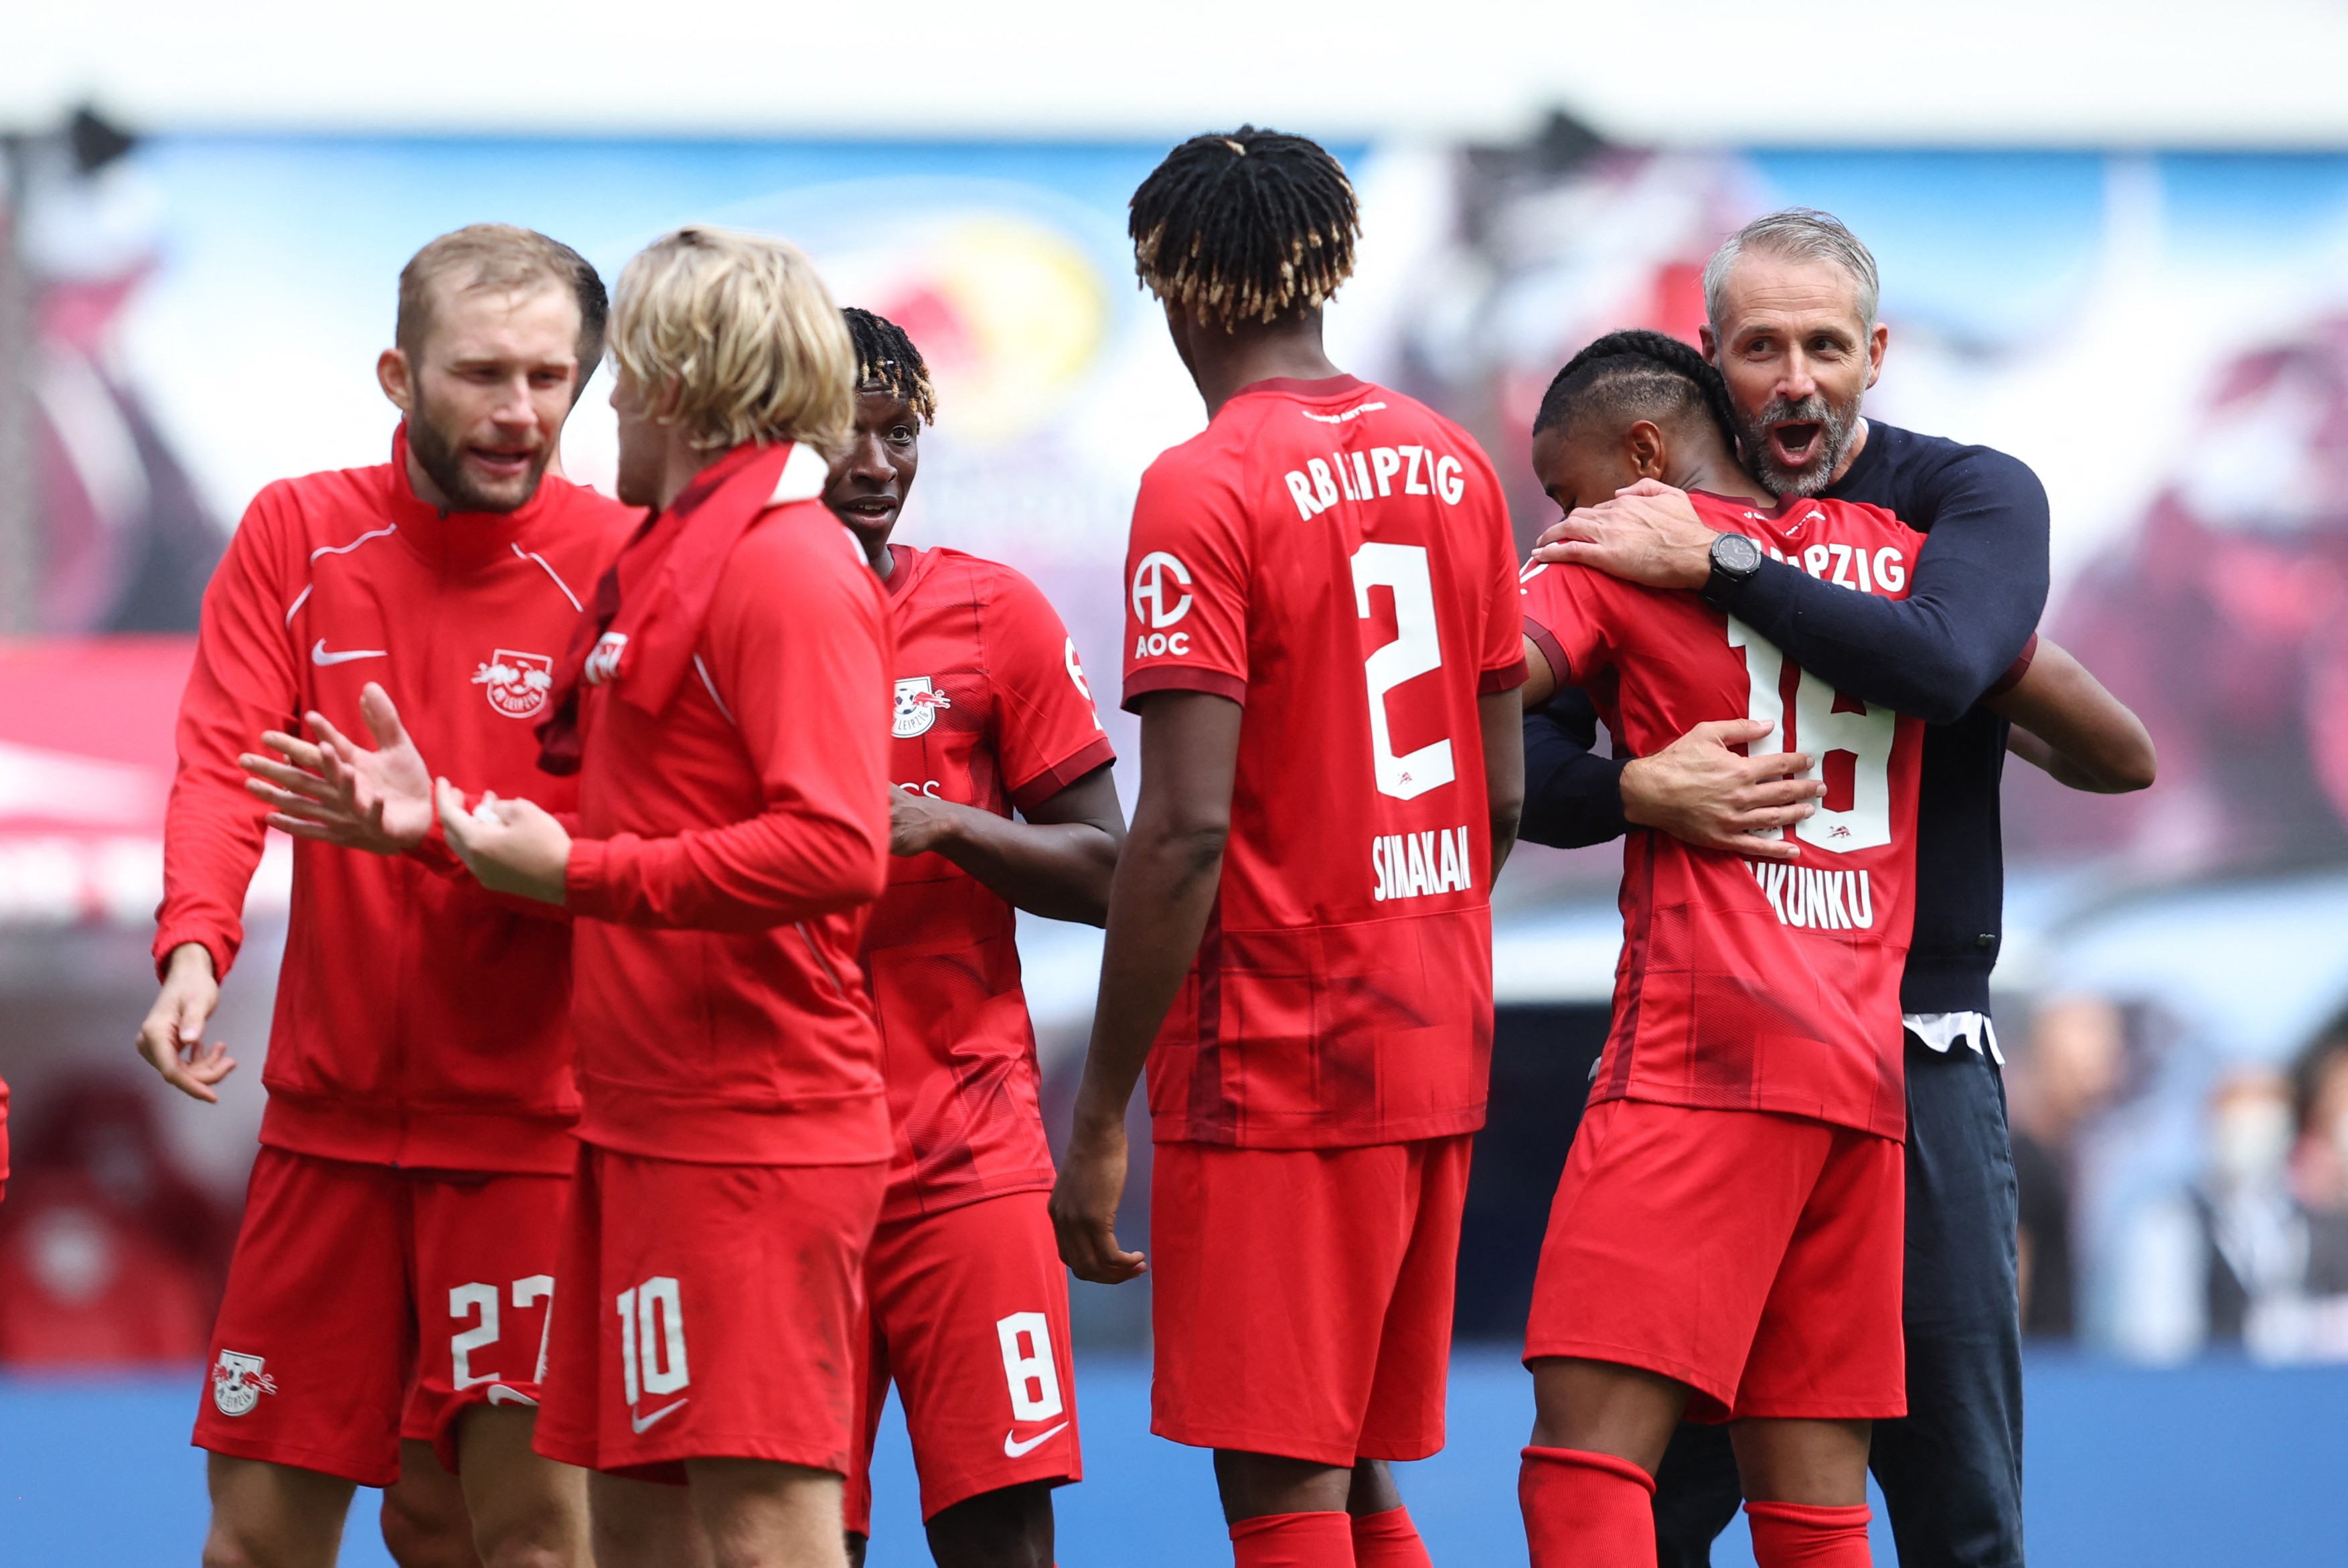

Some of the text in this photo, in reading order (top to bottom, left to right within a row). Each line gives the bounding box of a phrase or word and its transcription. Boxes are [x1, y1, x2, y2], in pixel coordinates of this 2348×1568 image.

[1285, 445, 1465, 522] RB LIPZIG
[1135, 631, 1190, 659] AOC
[1350, 542, 1456, 801] 2
[898, 711, 929, 730] LEIPZIG
[1727, 613, 1896, 854] 18
[449, 1274, 555, 1391] 27
[616, 1276, 690, 1406] 10
[996, 1312, 1063, 1422] 8
